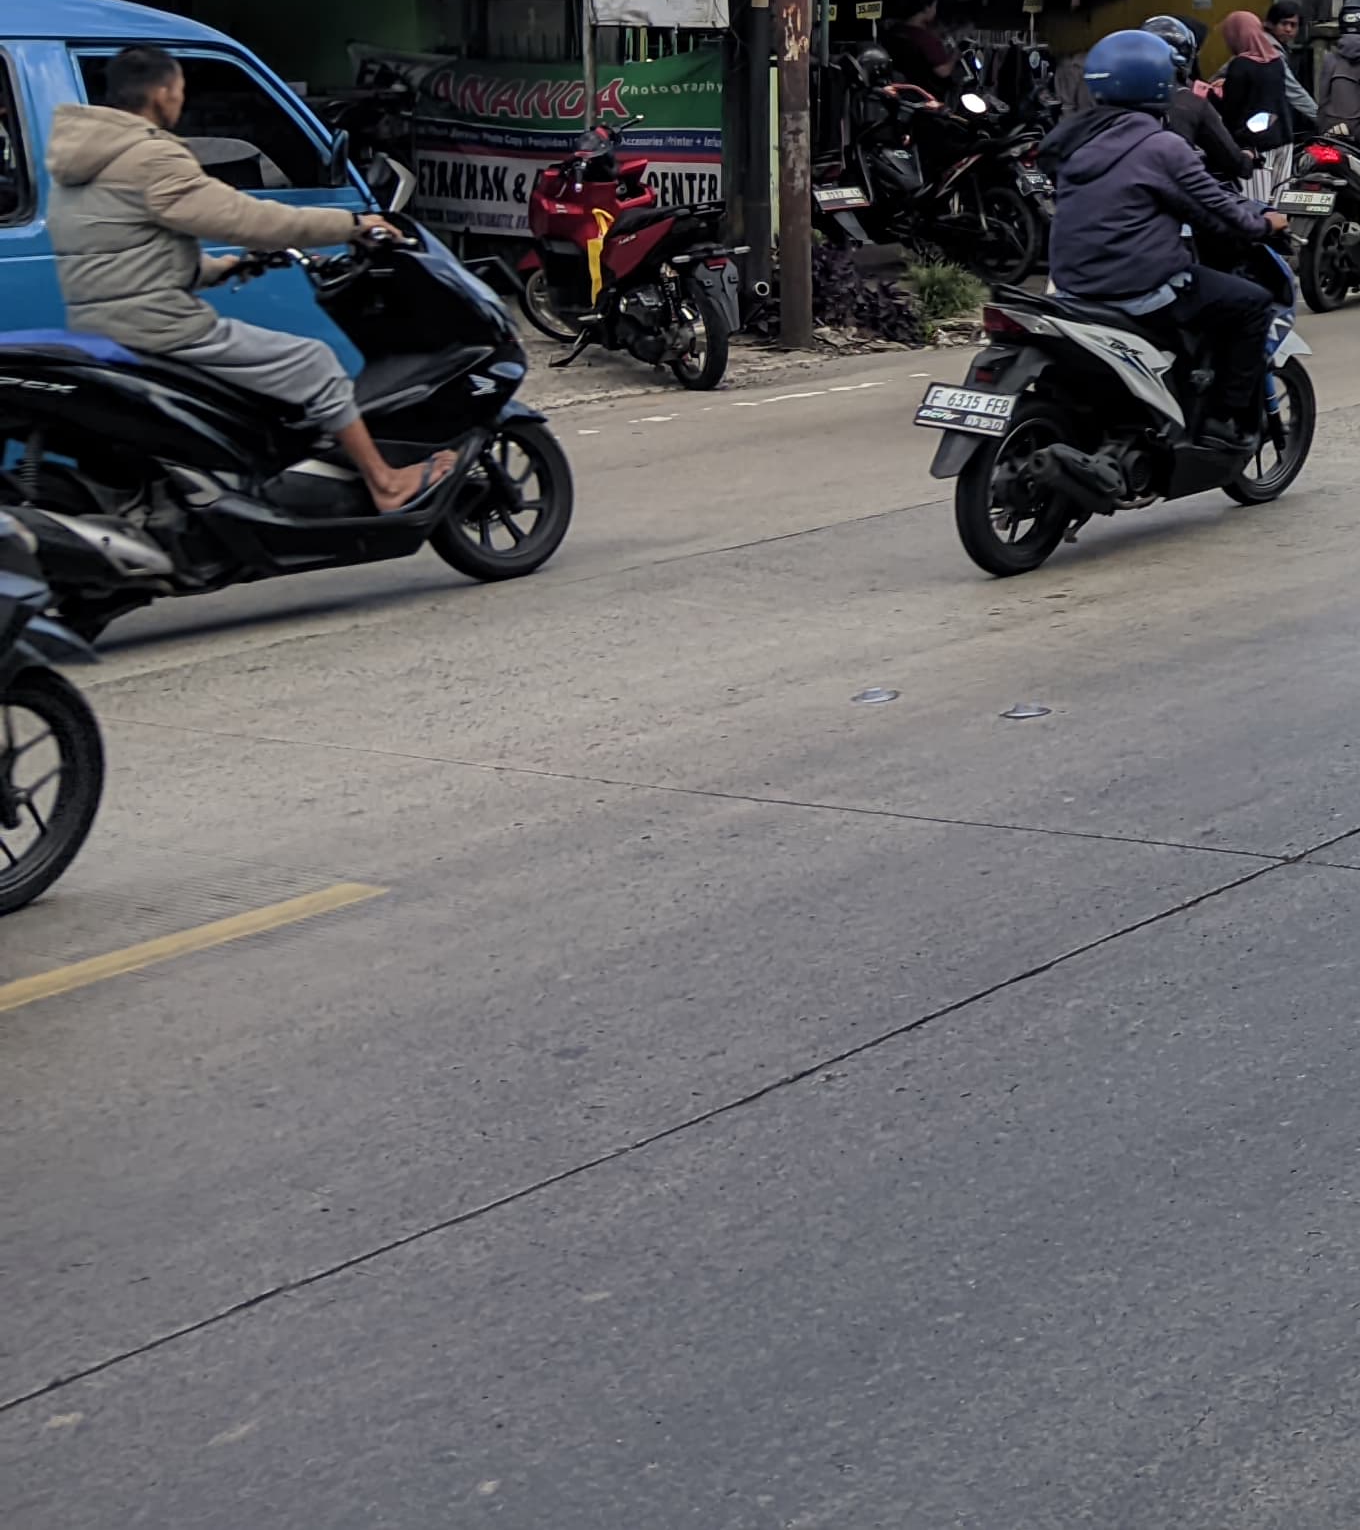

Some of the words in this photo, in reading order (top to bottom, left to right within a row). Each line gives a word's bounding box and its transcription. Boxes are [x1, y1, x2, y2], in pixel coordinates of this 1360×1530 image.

[620, 81, 723, 96] Photography
[931, 389, 943, 404] F
[947, 391, 980, 409] 6315
[984, 397, 1010, 413] FFB
